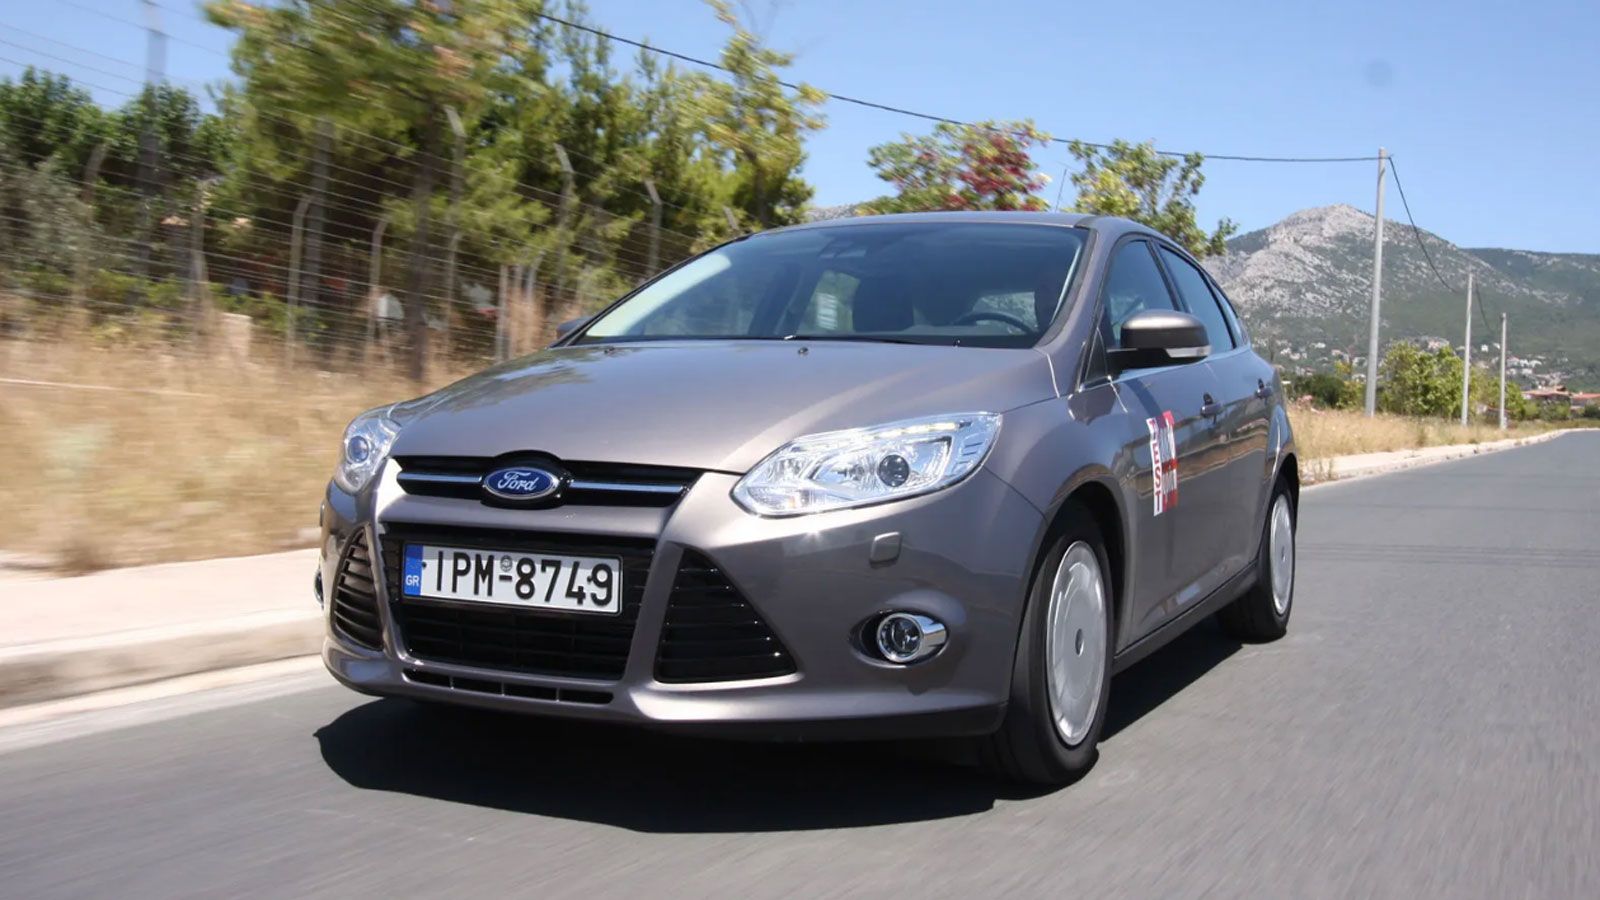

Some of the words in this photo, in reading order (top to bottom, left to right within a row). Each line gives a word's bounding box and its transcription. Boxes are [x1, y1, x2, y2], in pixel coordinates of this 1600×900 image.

[497, 470, 540, 491] Ford
[1149, 420, 1161, 512] TEST
[405, 574, 420, 586] GR
[436, 551, 613, 606] IPM-8749
